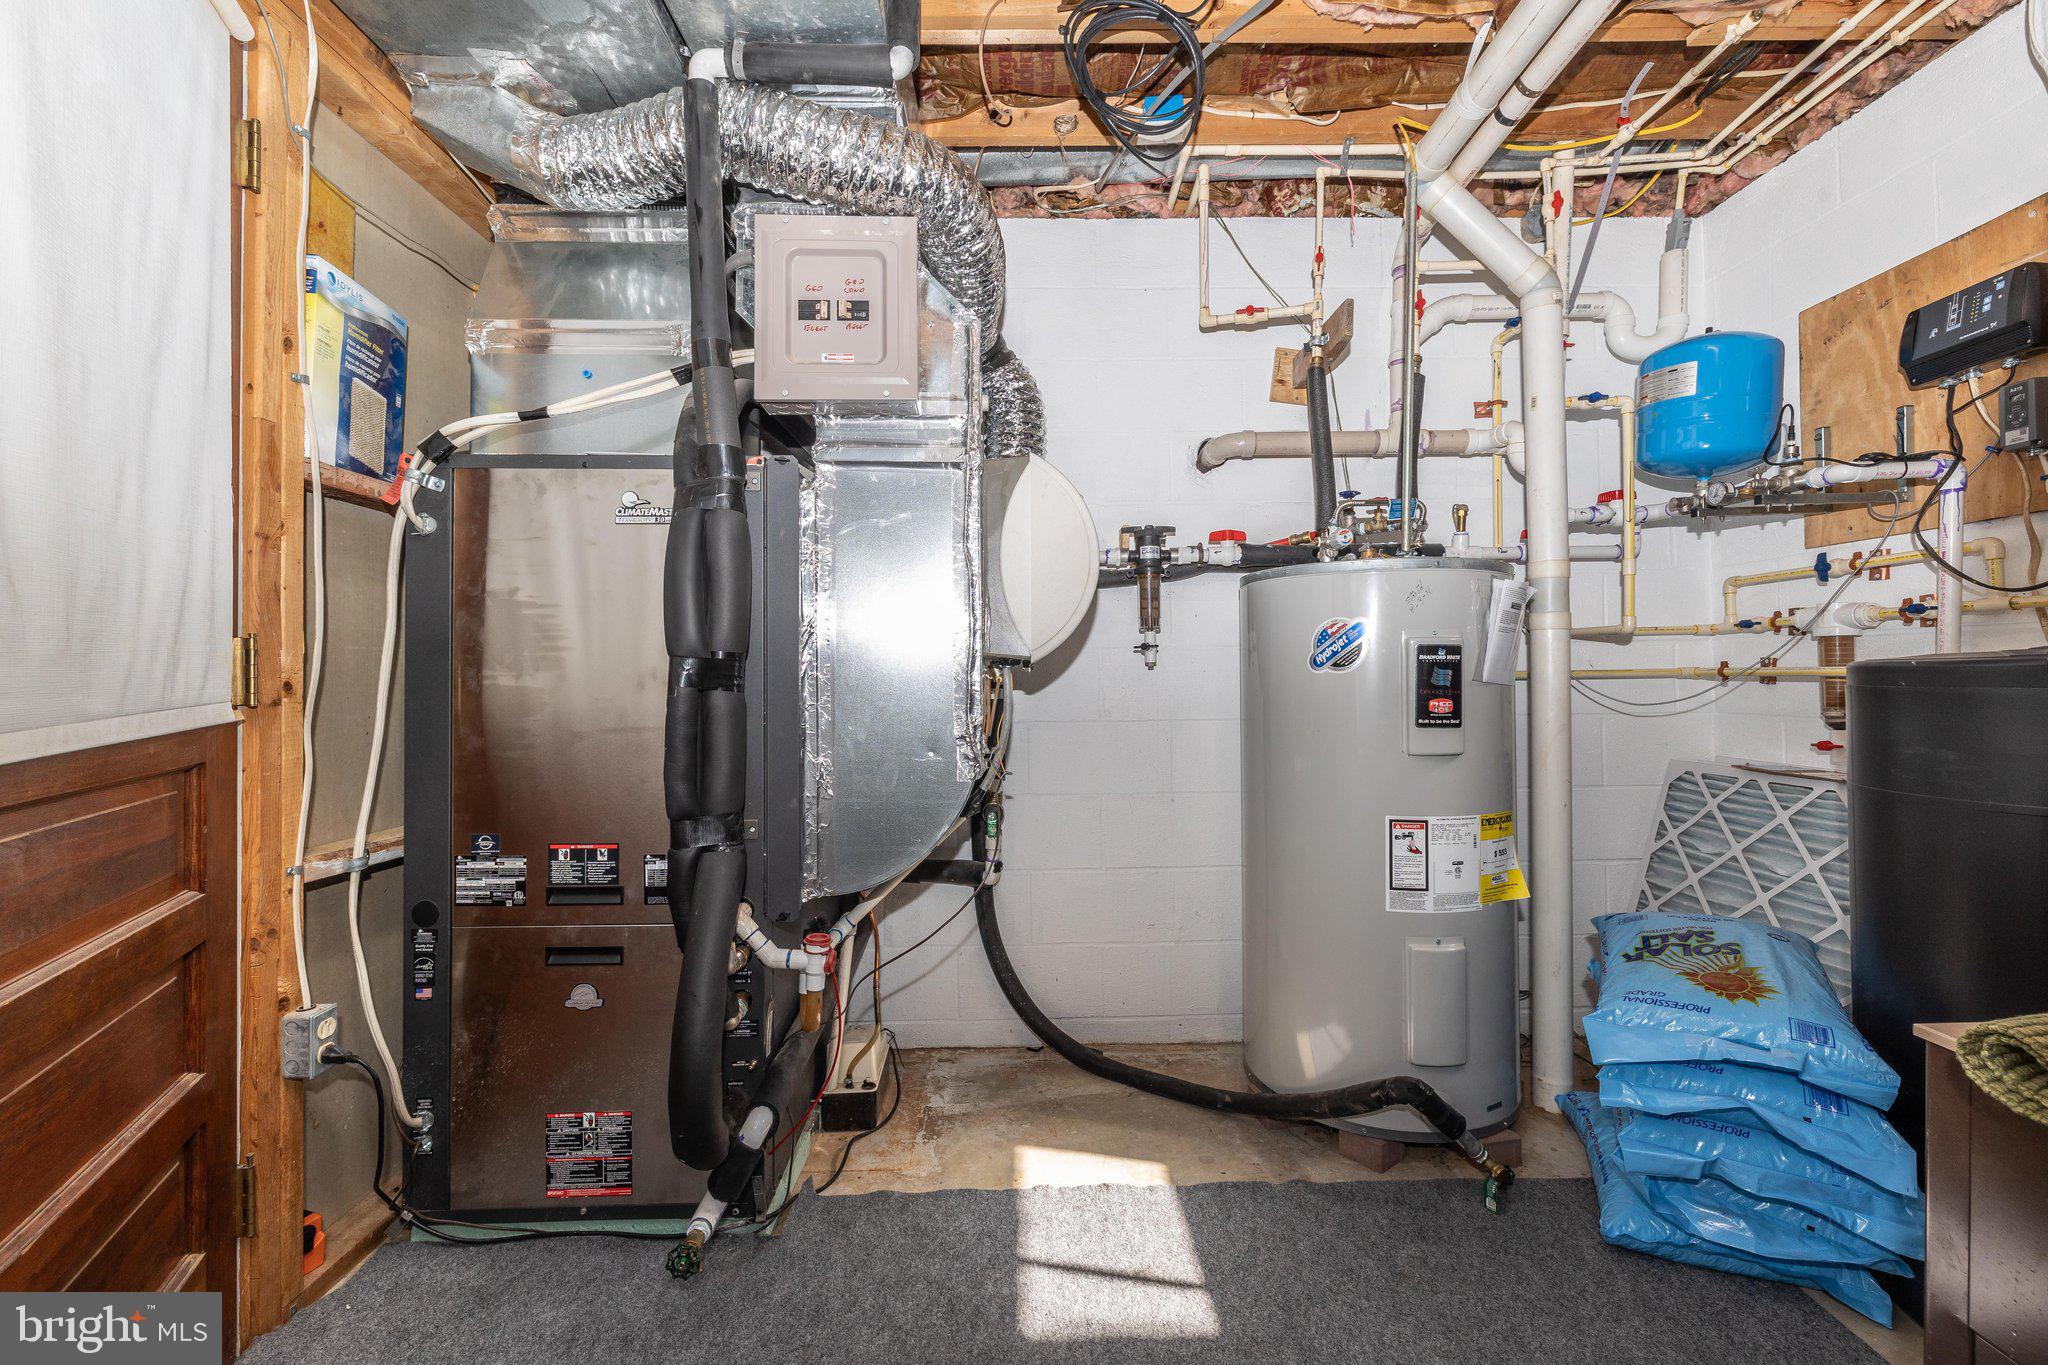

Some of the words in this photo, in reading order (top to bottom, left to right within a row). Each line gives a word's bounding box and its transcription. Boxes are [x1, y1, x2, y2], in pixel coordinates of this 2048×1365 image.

[337, 279, 365, 303] IDYLIS
[615, 507, 672, 516] CLIMATEMAST
[1315, 633, 1349, 665] Hydrojet
[1622, 942, 1742, 962] SOLAR
[1634, 930, 1716, 952] SALT
[1621, 995, 1711, 1014] PROFESSIONAL
[1671, 1114, 1750, 1139] PROFESSION
